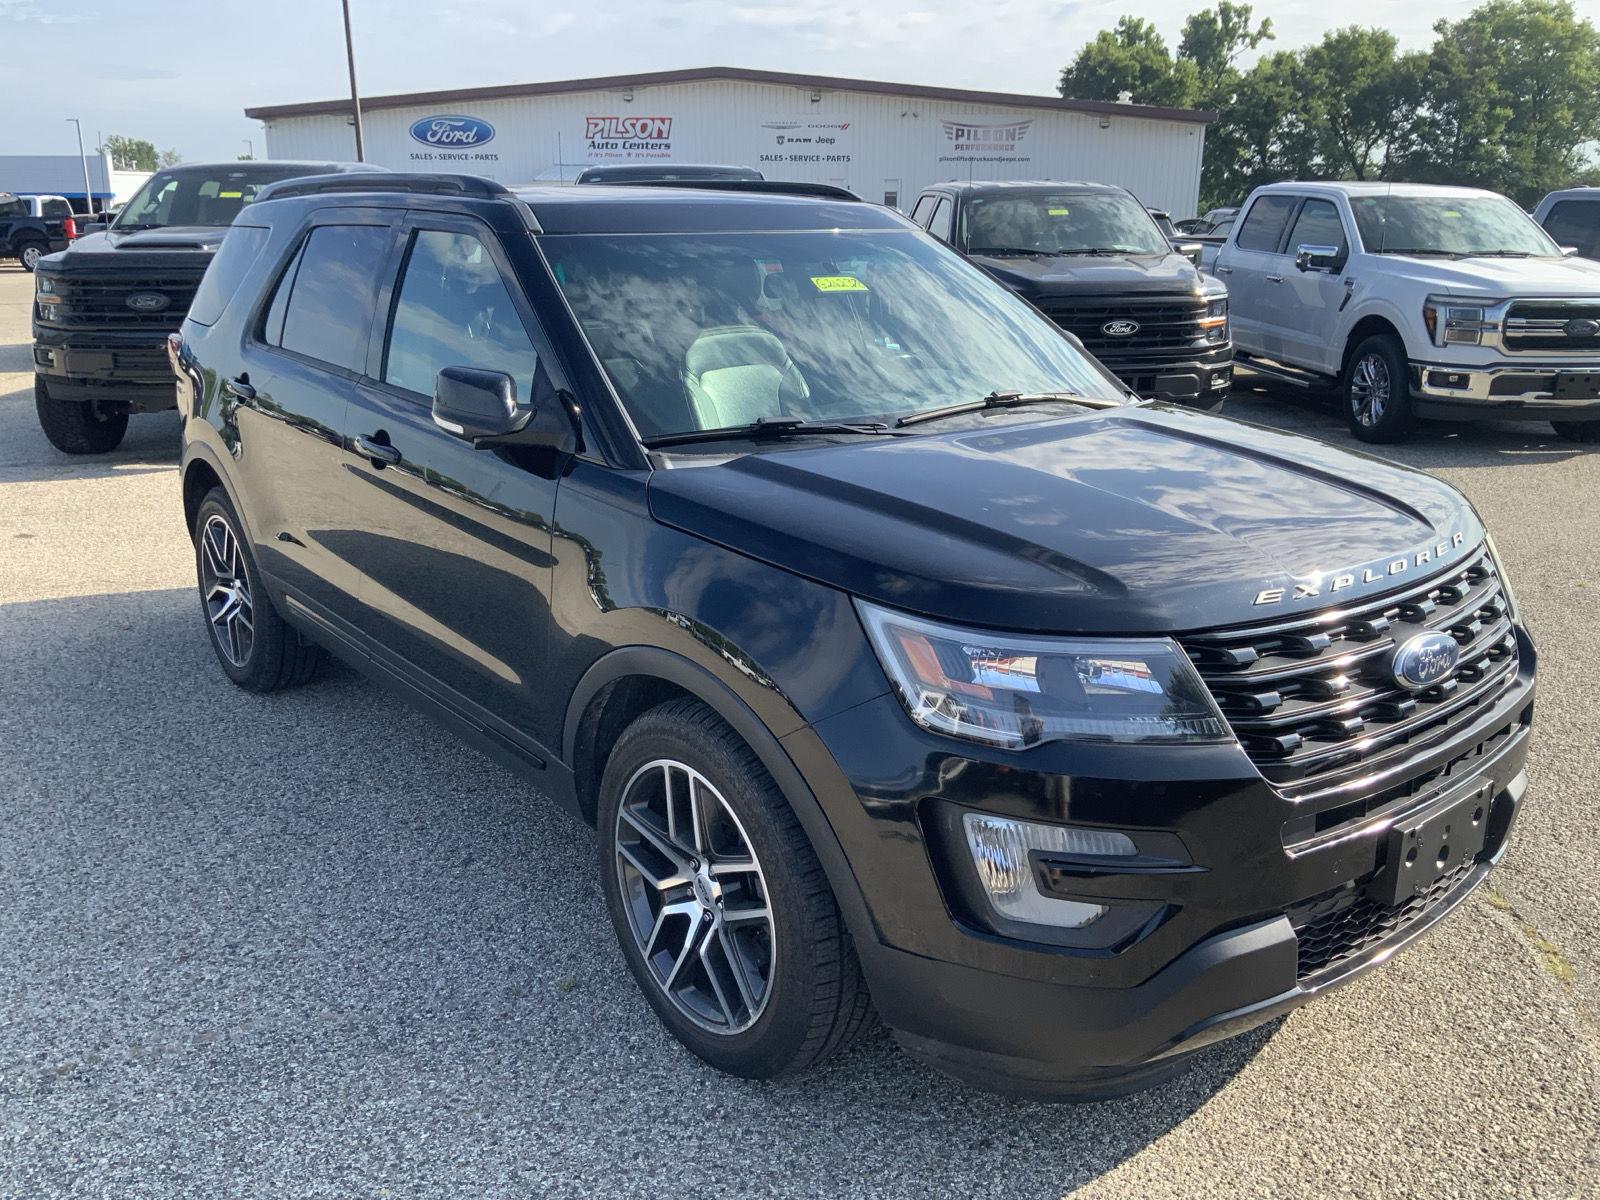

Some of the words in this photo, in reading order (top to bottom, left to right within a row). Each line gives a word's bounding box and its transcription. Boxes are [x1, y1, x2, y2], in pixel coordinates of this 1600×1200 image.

[426, 120, 478, 143] Ford
[585, 117, 672, 139] PILSON
[955, 127, 1017, 141] PILSON
[588, 140, 619, 150] Auto
[622, 140, 671, 150] Centers
[815, 136, 836, 145] Jeep
[954, 143, 1015, 151] PERFORMANCE
[438, 153, 469, 161] SERVICE
[474, 153, 499, 161] PARTS
[759, 154, 784, 162] SALES
[1253, 531, 1464, 605] EXPLORER
